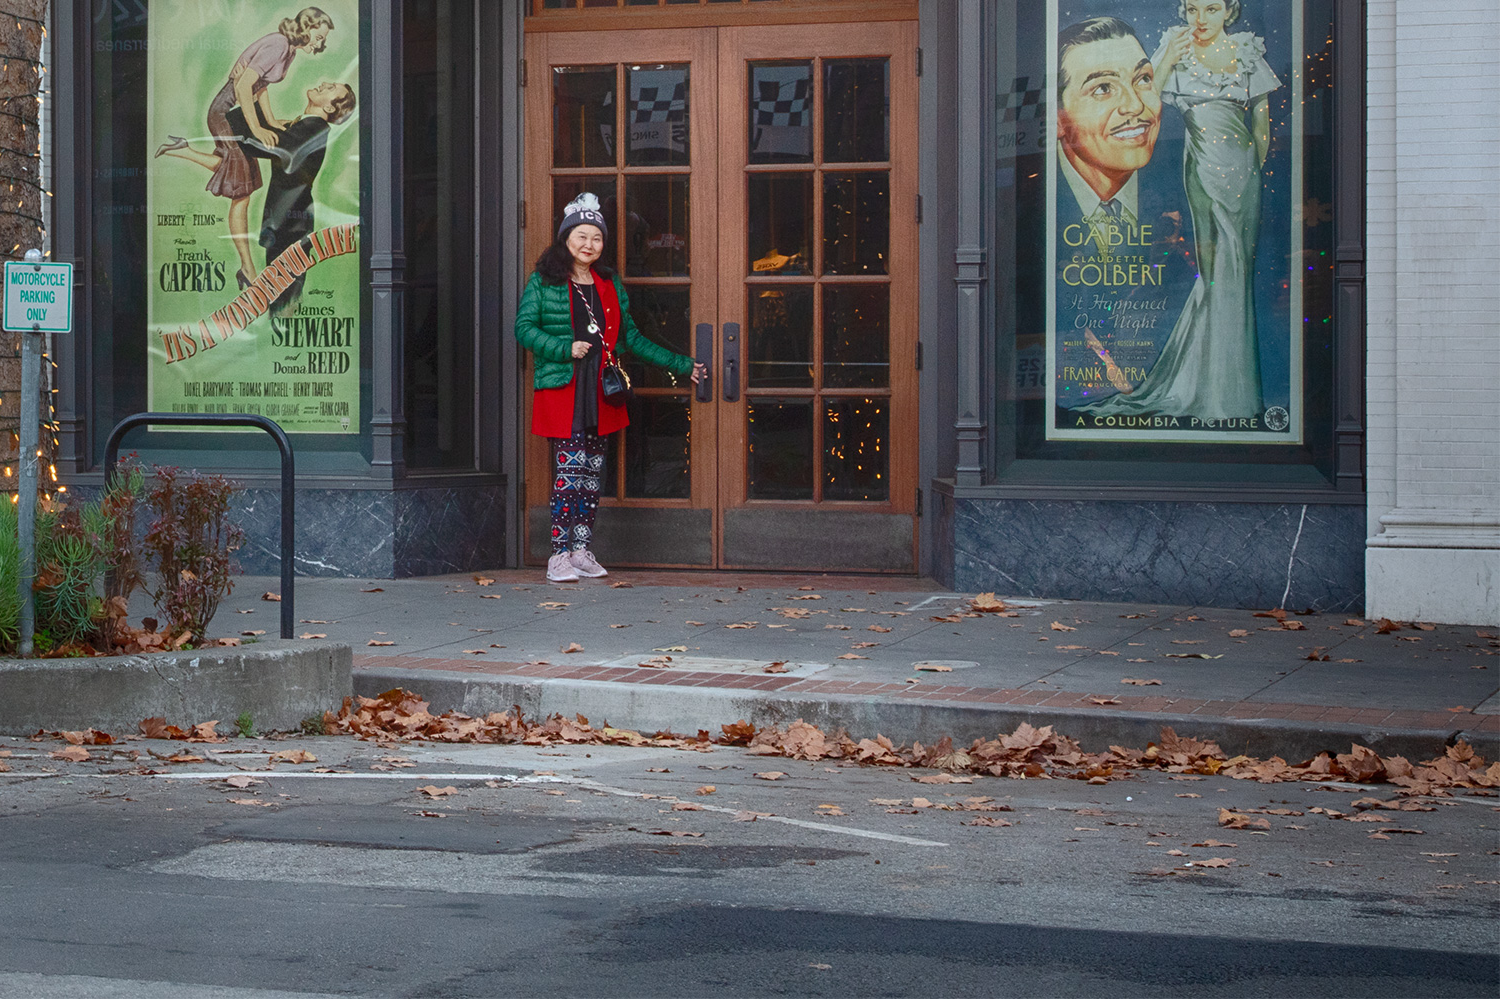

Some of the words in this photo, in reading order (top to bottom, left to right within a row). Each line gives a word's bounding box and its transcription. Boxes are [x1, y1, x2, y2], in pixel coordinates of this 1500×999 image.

[157, 214, 185, 226] LIBERTY
[193, 214, 215, 226] FILMS
[1063, 224, 1153, 246] GABLE
[176, 248, 212, 261] Frank
[11, 272, 65, 286] MOTORCYCLE
[159, 260, 226, 293] CAPRA'S
[1062, 264, 1166, 286] COLBERT
[20, 290, 55, 303] PARKING
[198, 319, 218, 352] A
[208, 240, 317, 342] WONDERFUL
[308, 288, 334, 299] starring
[294, 303, 335, 316] James
[1064, 293, 1084, 310] It
[1088, 293, 1168, 316] Happened
[26, 308, 47, 321] ONLY
[271, 316, 354, 348] STEWART
[1074, 313, 1104, 329] One
[1108, 313, 1157, 338] Night
[273, 361, 306, 375] Donna
[307, 351, 350, 375] REED
[284, 353, 300, 361] and
[1064, 366, 1102, 381] FRANK
[1106, 366, 1147, 381] CAPRA
[184, 382, 201, 397] LIONEL
[203, 382, 234, 397] BARRYMORE
[239, 382, 262, 397] THOMAS
[264, 382, 288, 397] MITCHELL
[293, 382, 310, 397] HENRY
[312, 382, 333, 397] TRAVERS
[320, 402, 334, 416] FRANK
[334, 402, 349, 416] CAPRA
[1076, 416, 1086, 426] A
[1094, 416, 1180, 428] COLUMBIA
[1190, 417, 1258, 429] PICTURE
